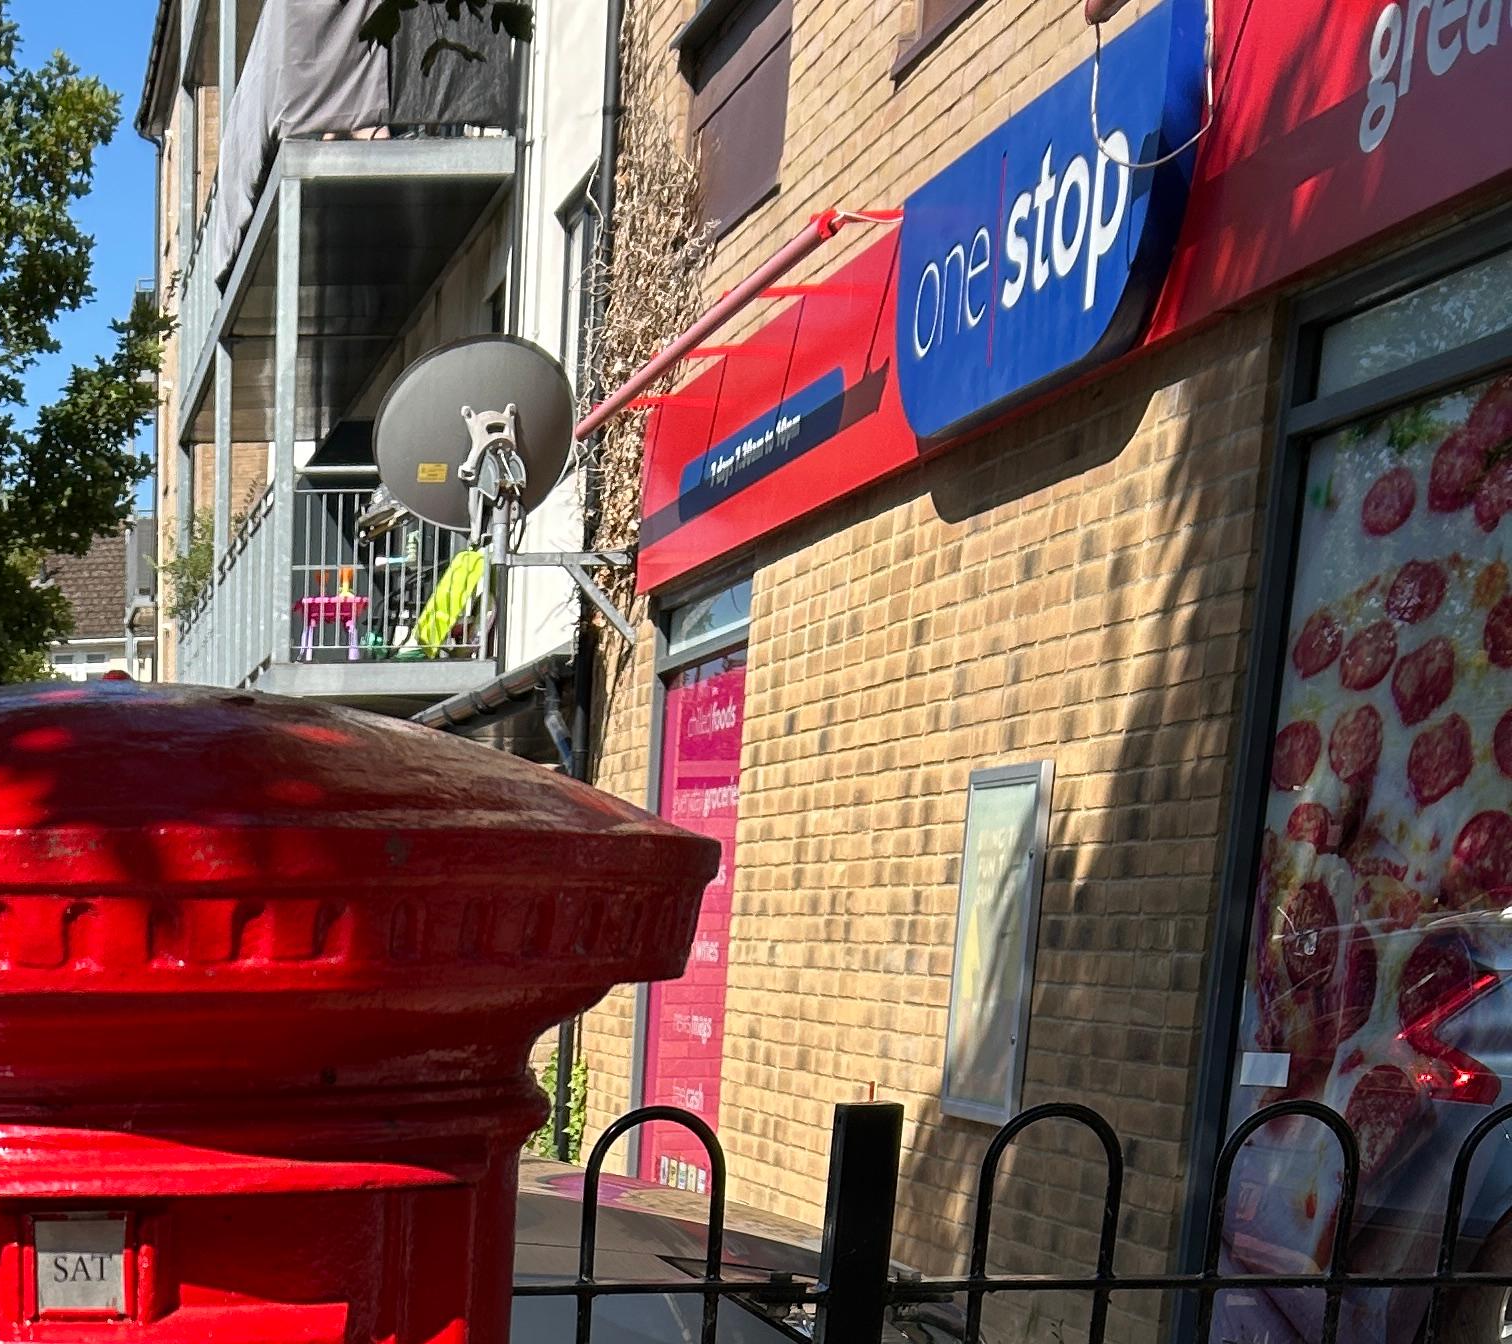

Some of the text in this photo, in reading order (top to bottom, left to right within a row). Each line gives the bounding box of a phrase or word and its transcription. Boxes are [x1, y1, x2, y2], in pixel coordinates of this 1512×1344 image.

[1359, 0, 1512, 153] grea
[913, 130, 1130, 359] one stop
[54, 1252, 113, 1282] SAT
